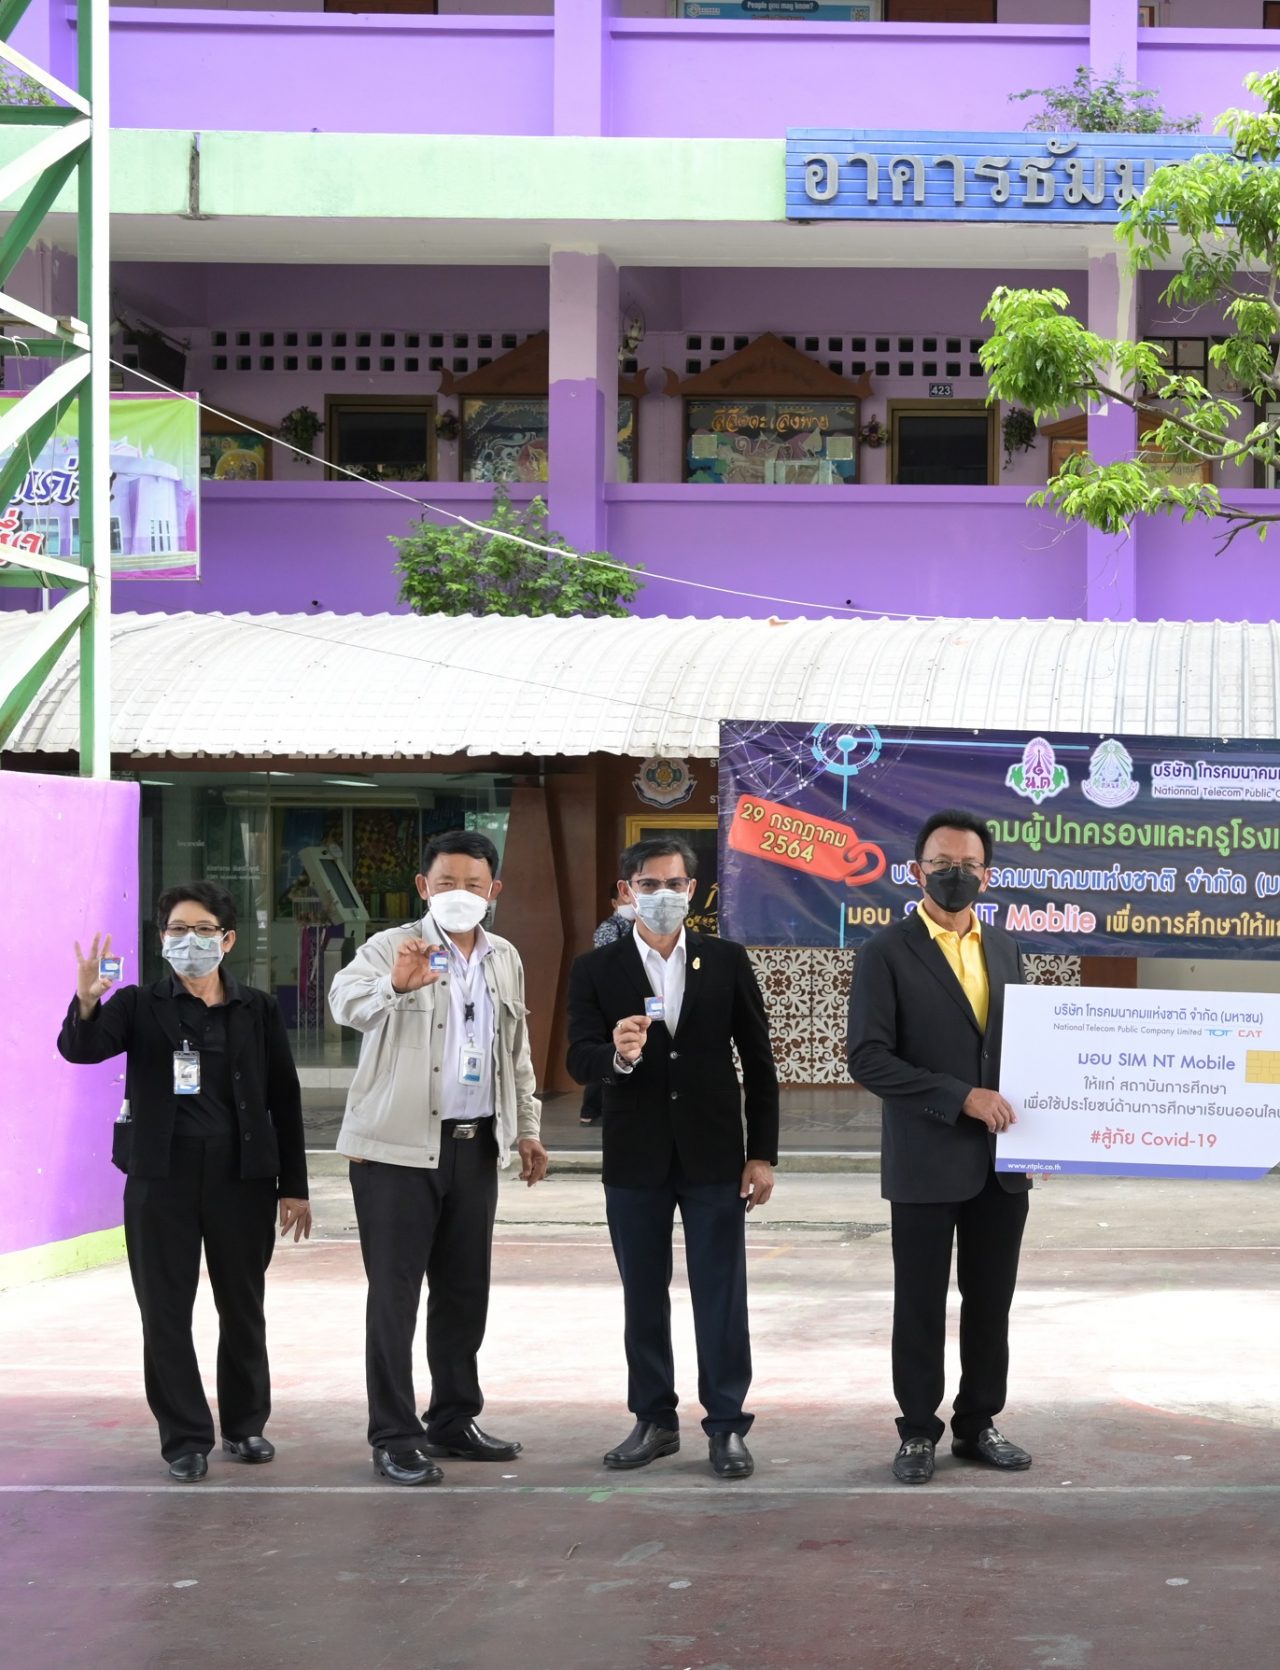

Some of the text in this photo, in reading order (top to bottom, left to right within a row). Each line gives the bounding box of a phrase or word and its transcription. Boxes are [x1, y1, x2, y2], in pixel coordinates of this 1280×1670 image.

[803, 138, 1180, 206] อาคารธัมม
[931, 386, 951, 396] 423
[1153, 761, 1192, 778] บริษัท
[1154, 785, 1199, 796] Nationnal
[1203, 786, 1241, 798] Telecom
[1245, 788, 1271, 799] Public
[740, 803, 848, 848] 29 กรกฎาคม
[759, 830, 815, 864] 2564
[987, 863, 1177, 893] รคมนาคมแห่งชาติ
[1186, 867, 1247, 895] จำกัด
[848, 906, 891, 925] มอบ
[1005, 902, 1098, 934] Moblie
[1053, 1004, 1264, 1025] บริษัท โทรคมนาคมแห่งชาติ จำกัด (มหาชน)
[1053, 1022, 1263, 1038] National Telecom Public Company Limited TOT CAT
[1078, 1052, 1236, 1071] มอบ SIM NT Mobile
[1084, 1076, 1227, 1095] ให้แก่ สถาบันการศึกษา
[1090, 1128, 1217, 1150] #สู้ภัย Covid-19
[1007, 1162, 1062, 1171] www.ntplc.co.th
